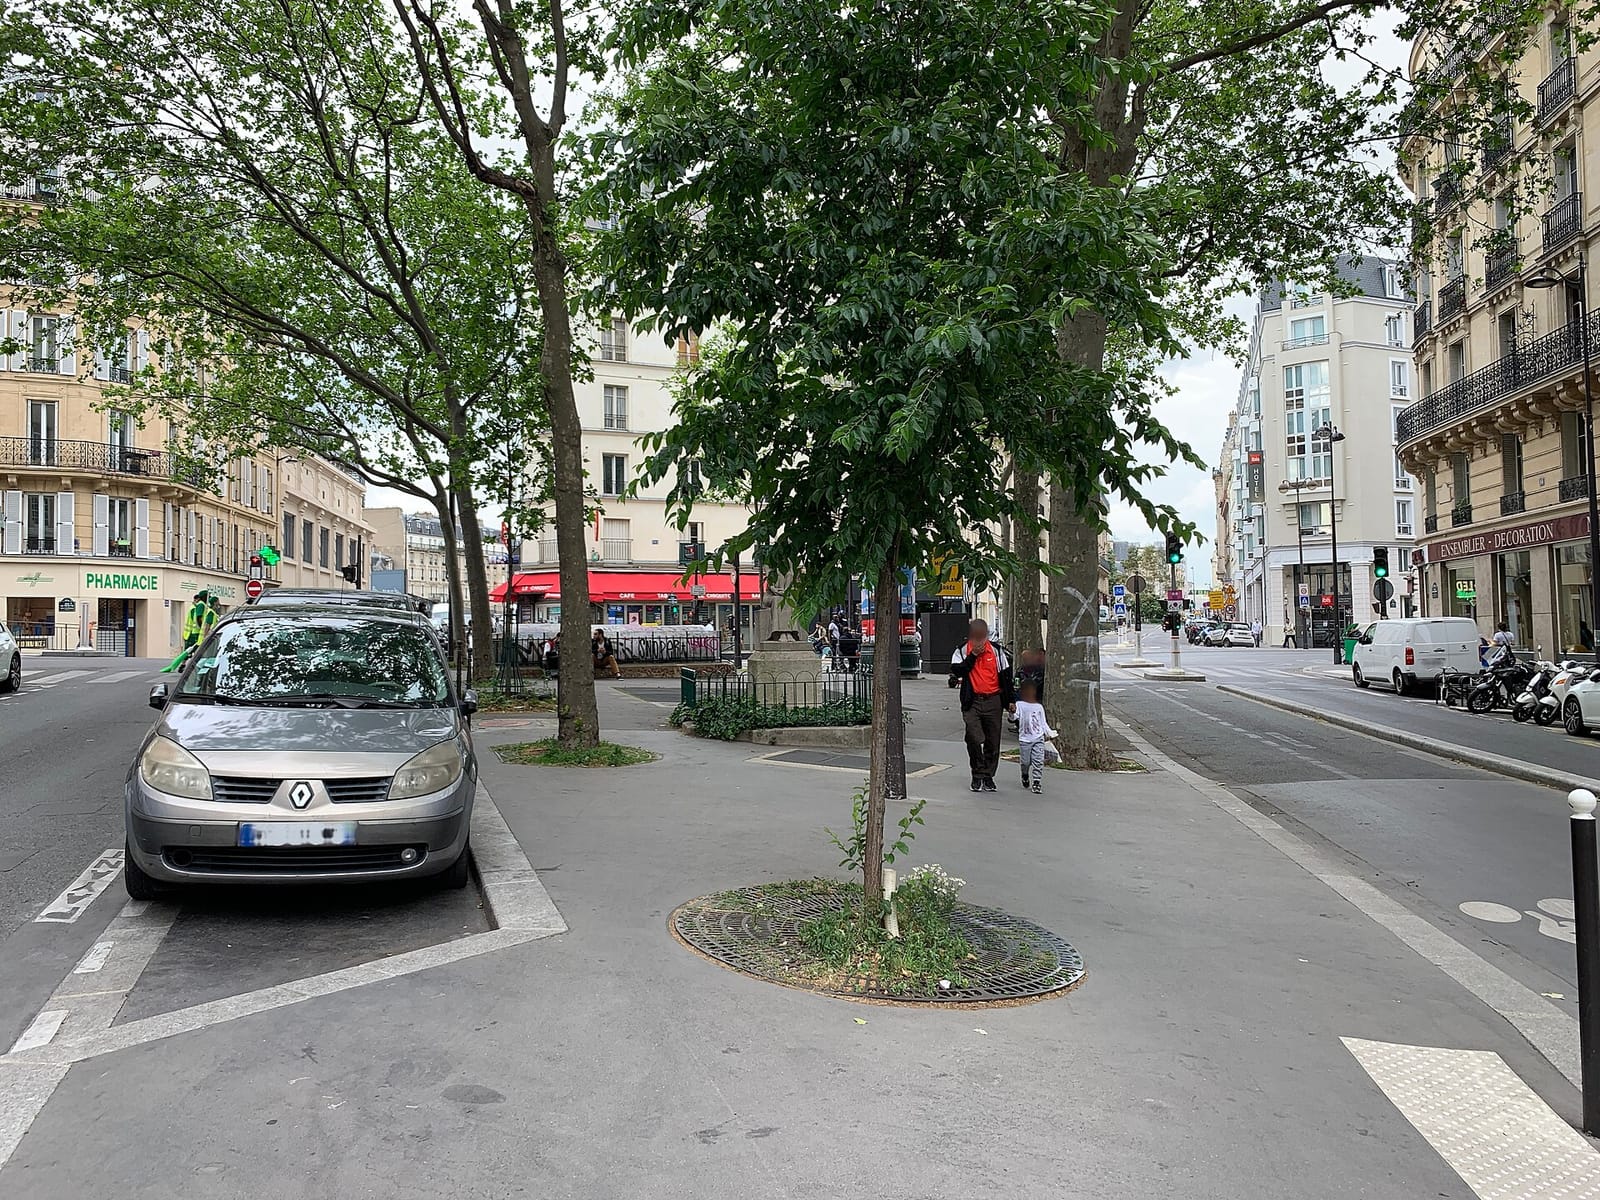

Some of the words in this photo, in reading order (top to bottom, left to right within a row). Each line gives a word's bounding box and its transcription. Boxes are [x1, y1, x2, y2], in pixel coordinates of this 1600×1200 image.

[1440, 536, 1486, 558] ENSEMBLIER
[1494, 522, 1554, 548] DECORATION
[86, 573, 158, 590] PHARMACIE
